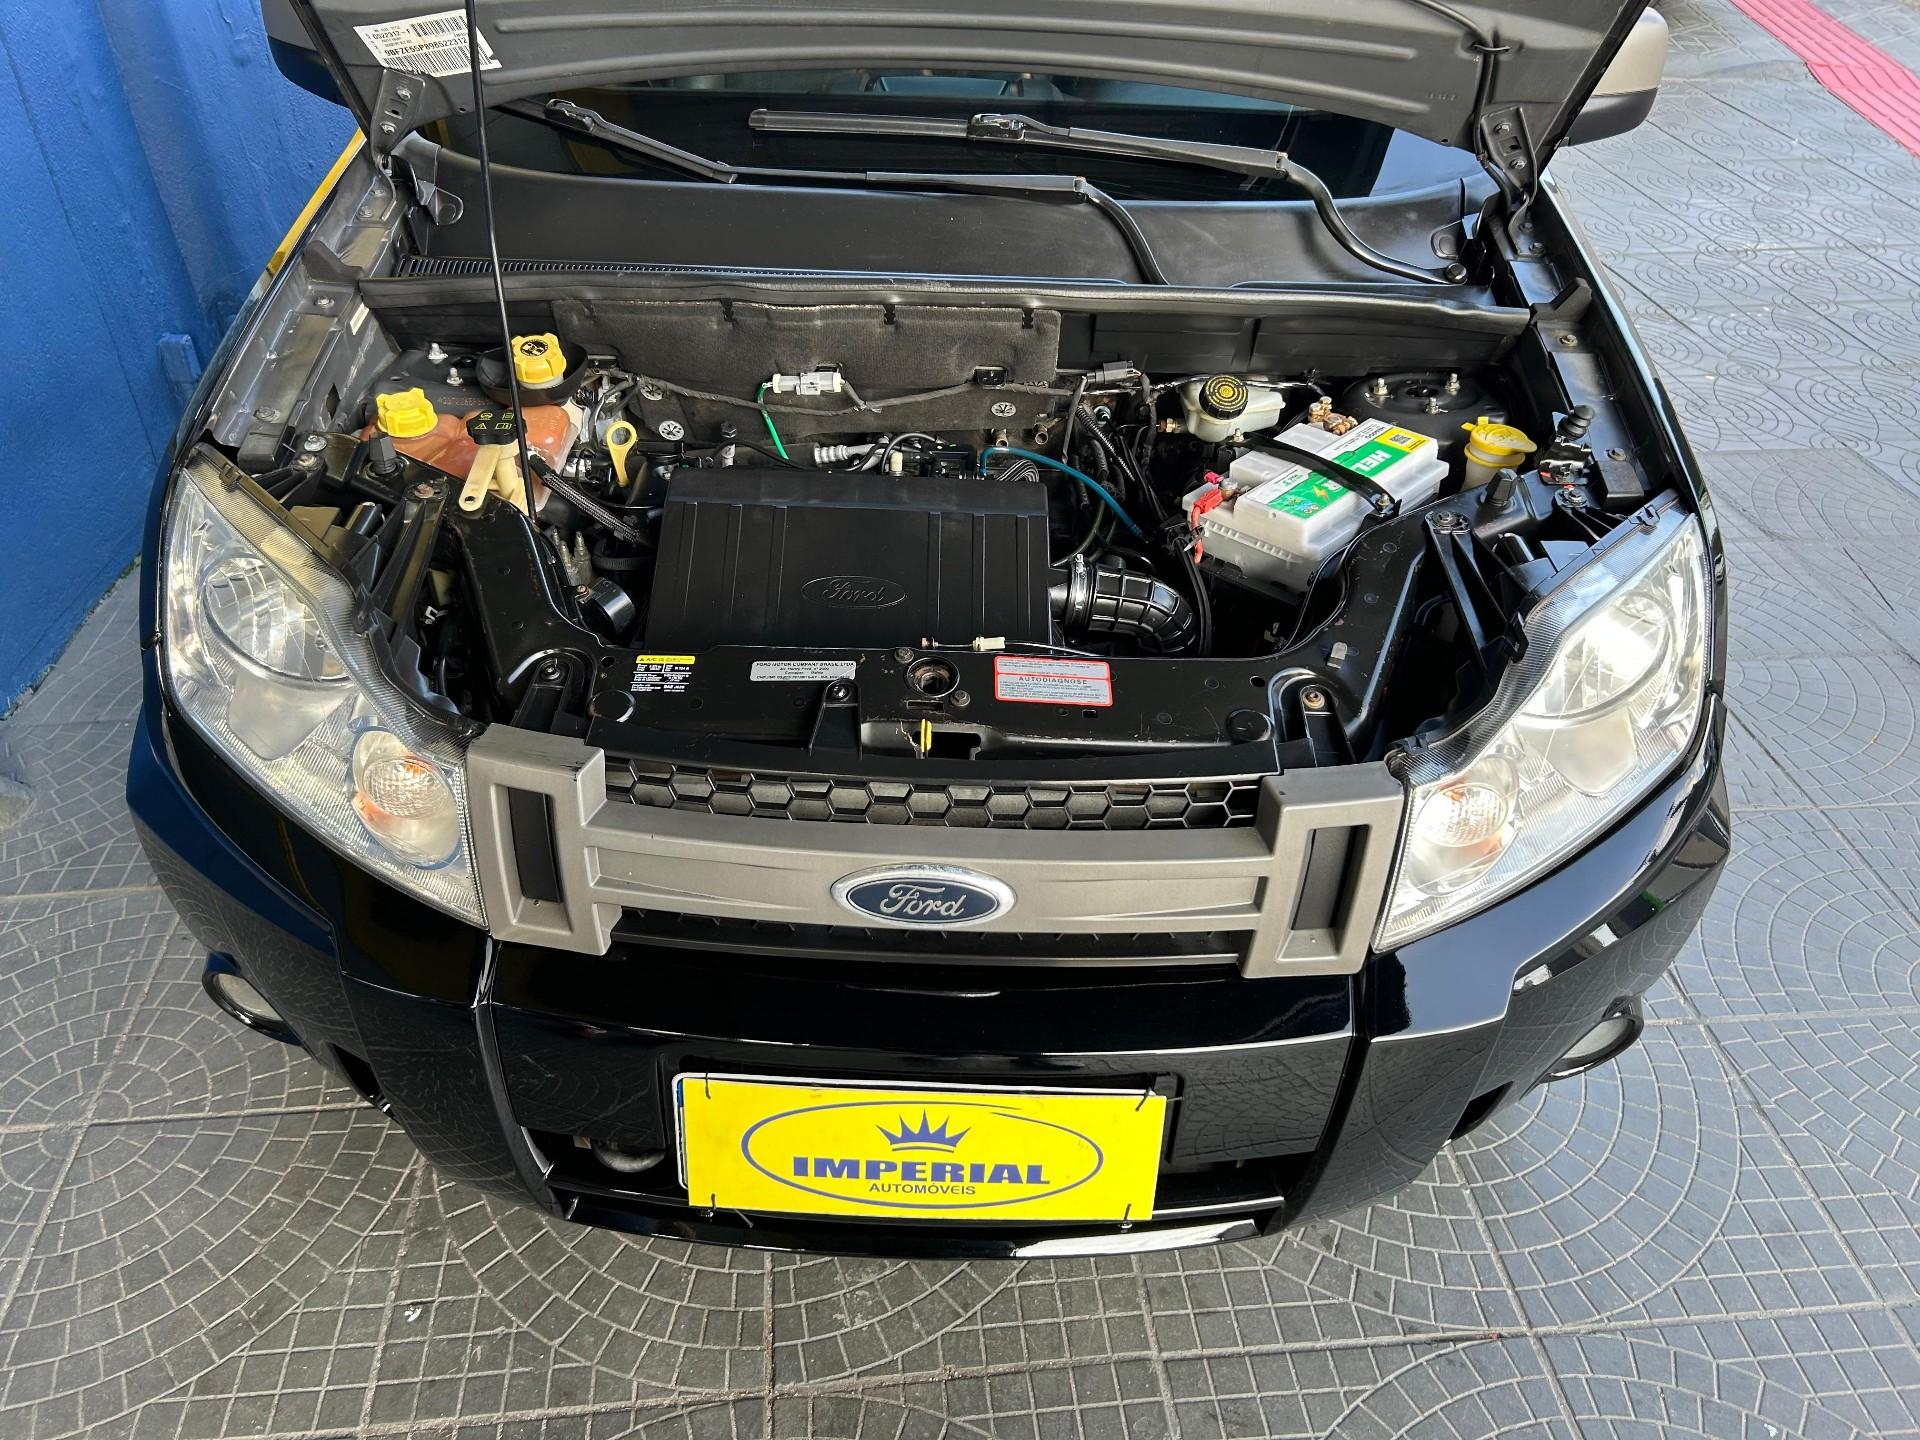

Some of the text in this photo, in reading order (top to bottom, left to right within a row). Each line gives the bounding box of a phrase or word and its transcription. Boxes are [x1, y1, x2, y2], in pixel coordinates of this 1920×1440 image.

[822, 579, 885, 602] Ford
[1018, 676, 1088, 685] AUTODIAGNOSE
[880, 883, 967, 917] Ford
[793, 1156, 1051, 1184] IMPERIAL
[868, 1182, 976, 1195] AUTOMÓVEIS
